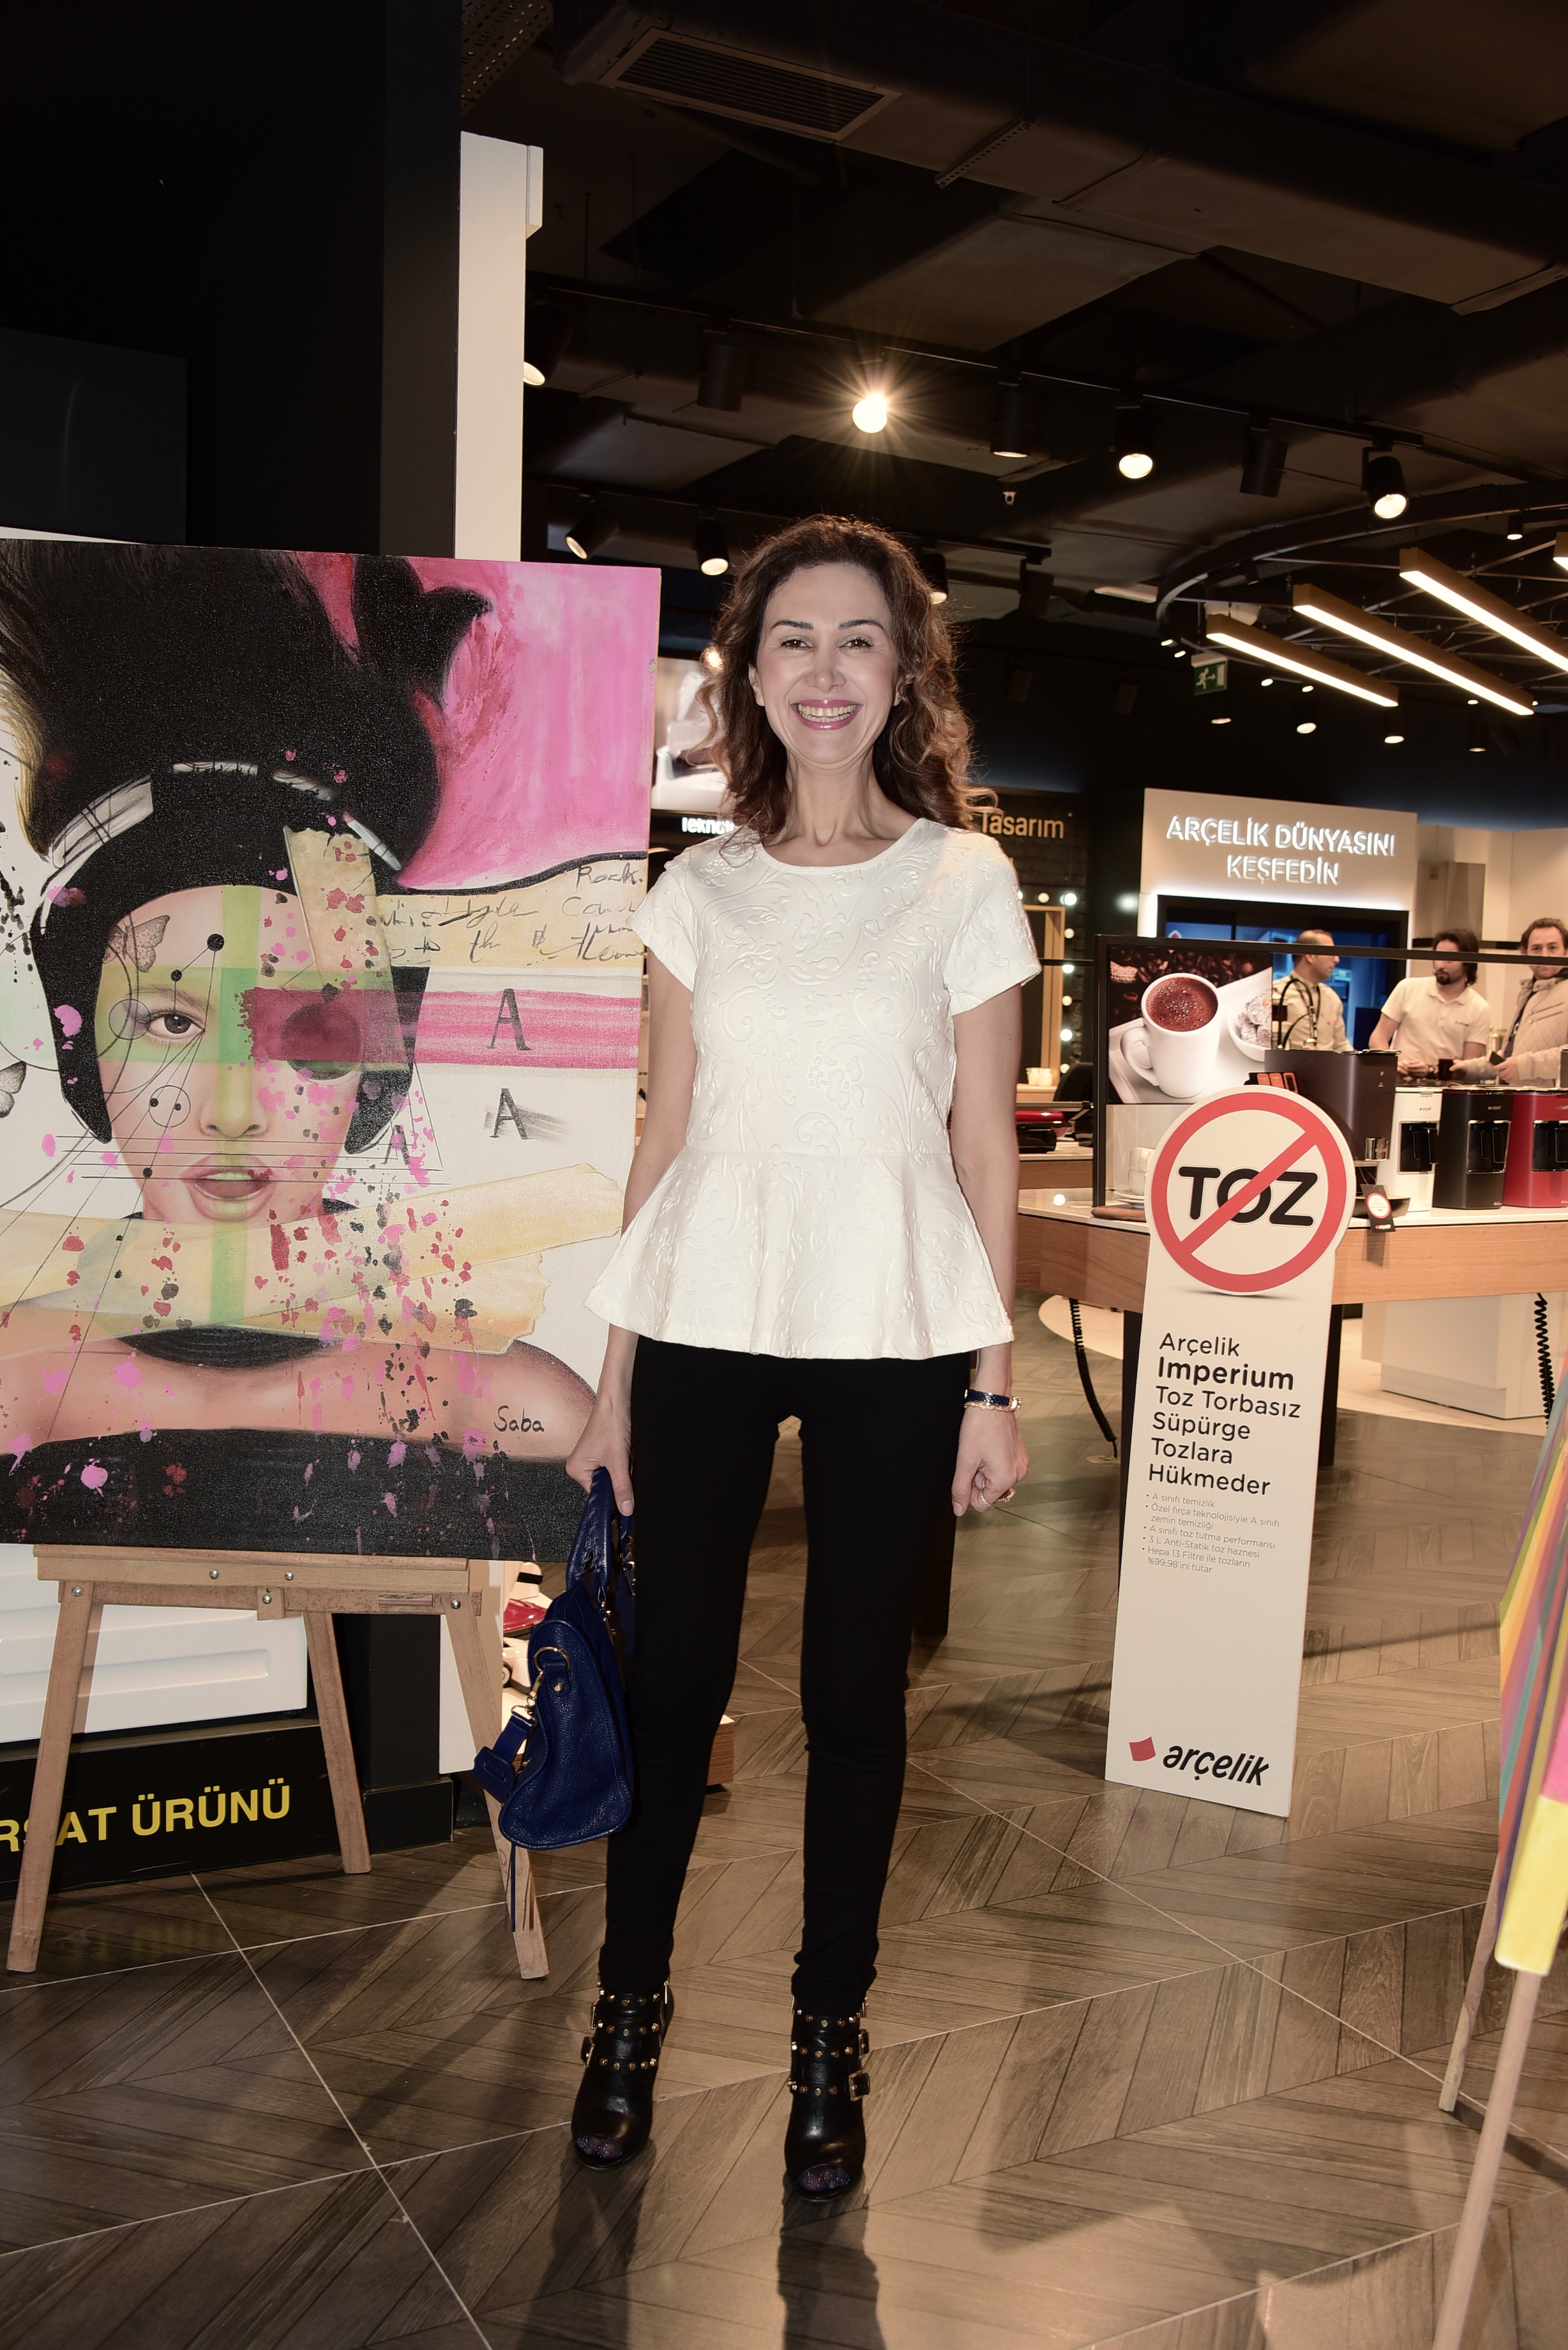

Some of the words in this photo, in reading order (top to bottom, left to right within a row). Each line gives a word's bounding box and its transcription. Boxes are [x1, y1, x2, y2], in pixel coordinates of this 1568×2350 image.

[1166, 815, 1270, 847] ARÇELİK
[1275, 821, 1396, 857] DÜNYASINI
[1226, 854, 1339, 886] KEŞFEDİN
[486, 988, 532, 1051] A
[488, 1088, 534, 1141] A
[1179, 1166, 1318, 1226] TOZ
[1159, 1332, 1240, 1357] Arçelik
[1158, 1356, 1293, 1391] Imperium
[1155, 1385, 1194, 1407] Toz
[1202, 1390, 1301, 1418] Torbasız
[494, 1405, 545, 1432] Saba
[1152, 1411, 1250, 1441] Süpürge
[1150, 1437, 1233, 1464] Tozlara
[1149, 1463, 1270, 1496] Hükmeder
[1151, 1503, 1170, 1513] Özel
[1172, 1506, 1191, 1516] fırça
[1193, 1510, 1248, 1524] teknolojisiyle
[1250, 1517, 1257, 1525] A
[1260, 1519, 1279, 1528] sınıfı
[1161, 1495, 1180, 1503] sınıfı
[1182, 1497, 1215, 1508] temizlik
[1150, 1515, 1175, 1524] zemin
[1178, 1519, 1214, 1531] temizliği
[1158, 1527, 1177, 1535] sınıfı
[1180, 1529, 1193, 1538] toz
[1196, 1531, 1221, 1542] tutma
[1223, 1536, 1276, 1549] performansı
[1147, 1546, 1170, 1557] Hepa
[1172, 1549, 1180, 1558] 13
[1182, 1550, 1204, 1561] Filtre
[1206, 1554, 1216, 1563] ile
[1218, 1556, 1250, 1568] tozların
[1163, 1538, 1209, 1551] Anti-Statik
[1211, 1544, 1225, 1553] toz
[1227, 1547, 1260, 1558] haznesi
[1192, 1564, 1212, 1573] tutar
[1163, 1745, 1269, 1786] arçelik
[132, 1777, 290, 1837] ÜRÜNÜ
